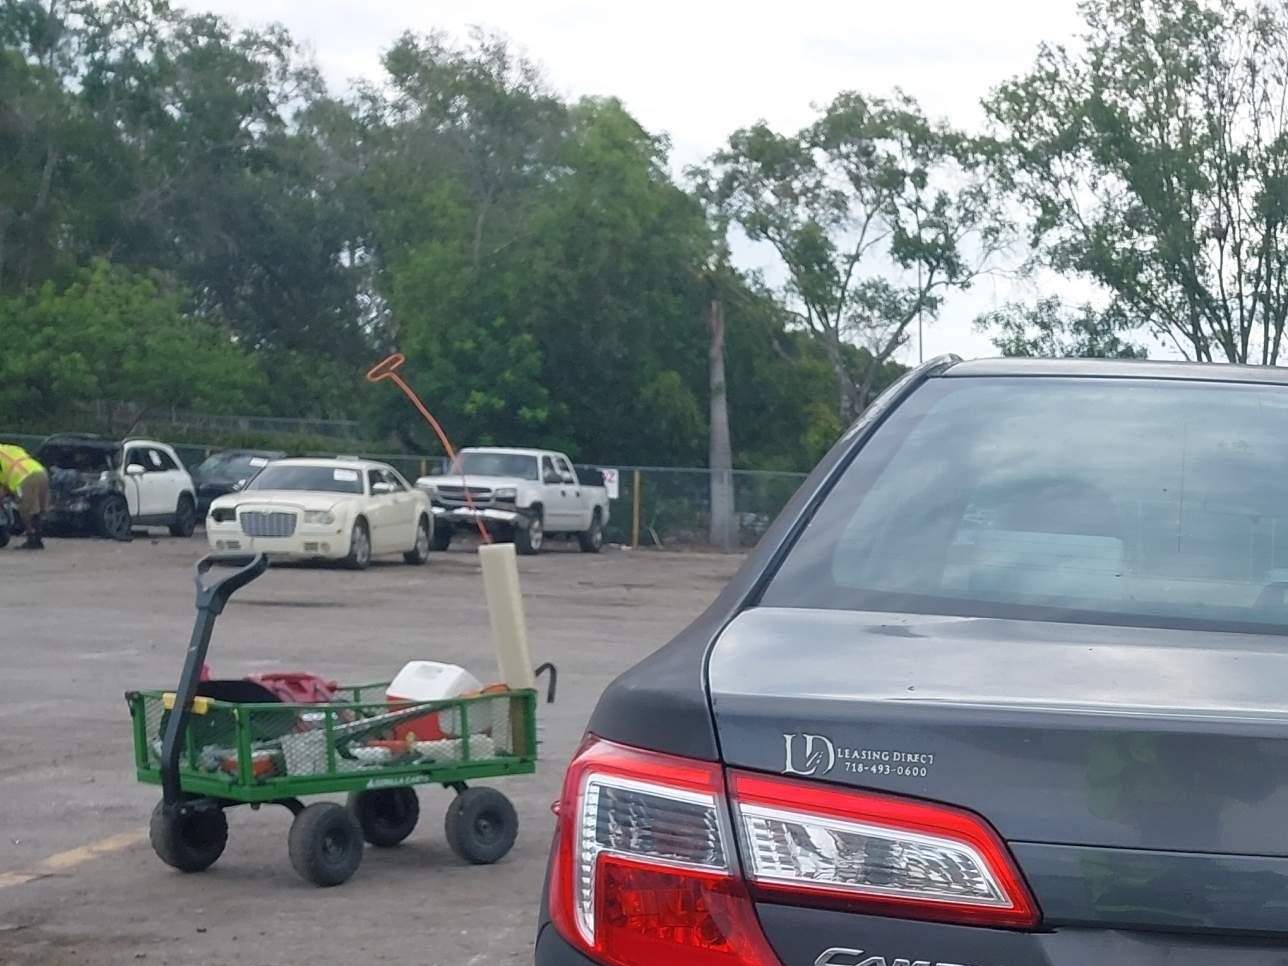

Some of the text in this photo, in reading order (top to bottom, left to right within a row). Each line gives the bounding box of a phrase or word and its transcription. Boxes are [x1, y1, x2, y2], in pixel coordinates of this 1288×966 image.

[837, 748, 934, 764] LEASING DIRECT
[845, 762, 927, 777] 718-493-0600
